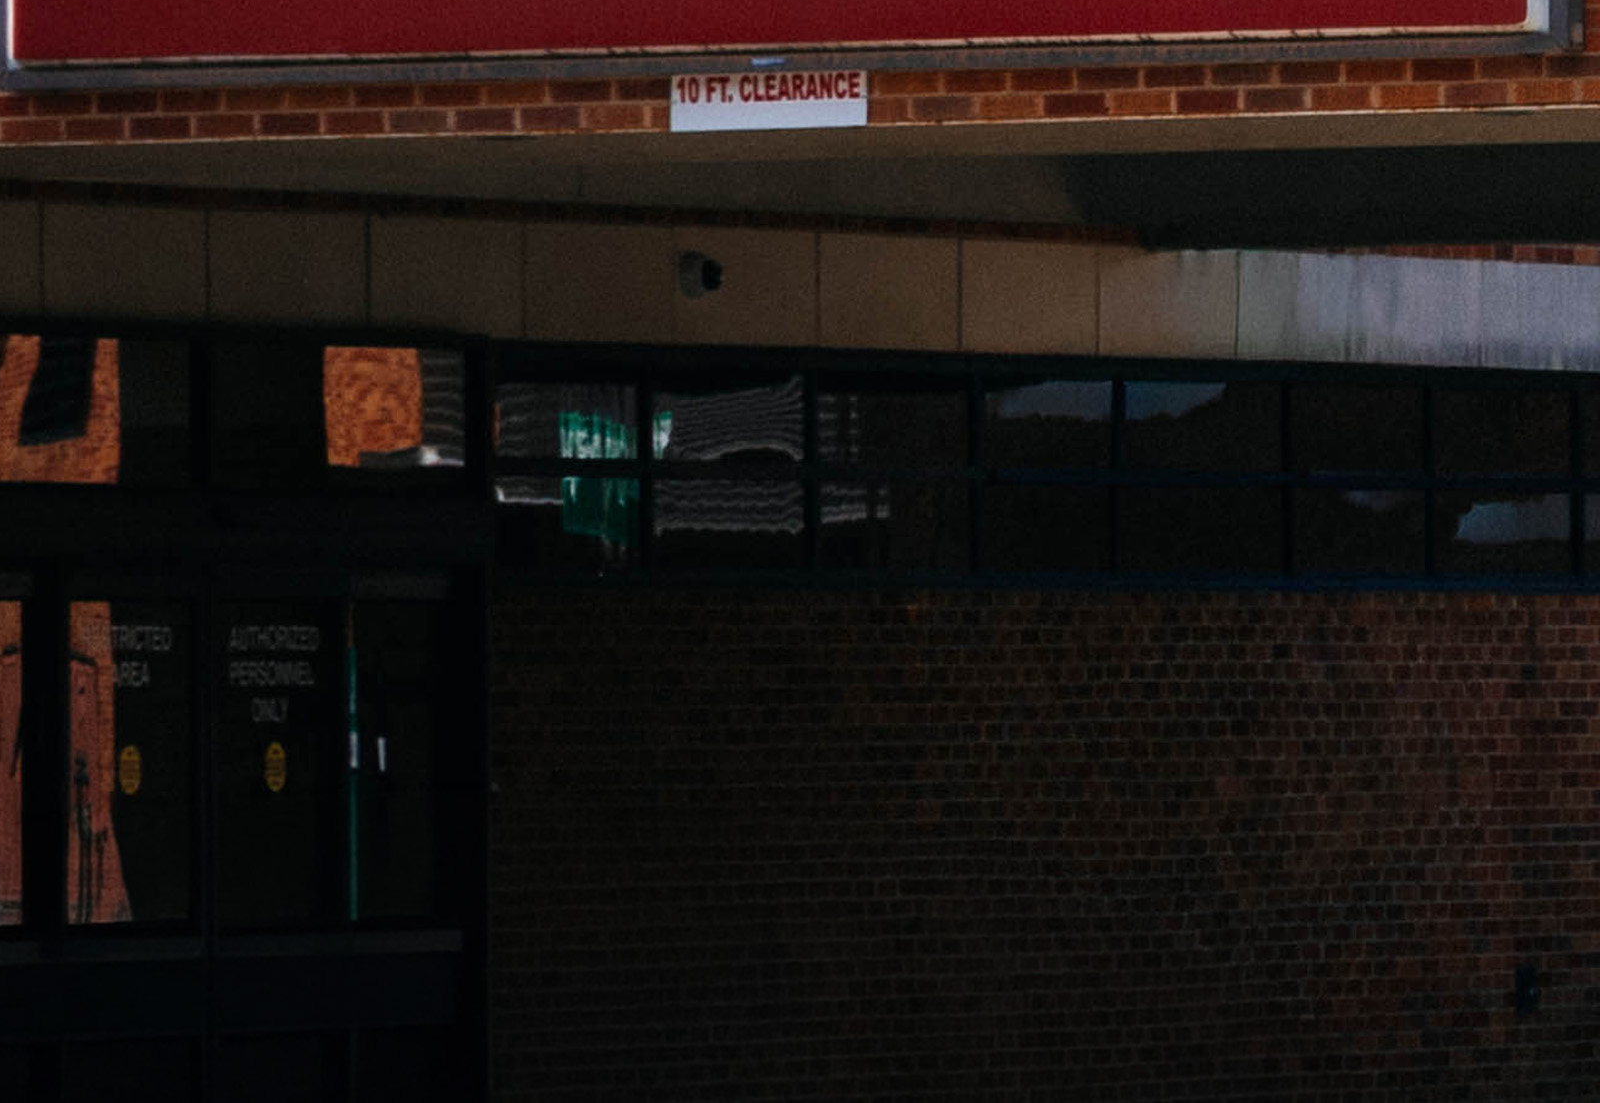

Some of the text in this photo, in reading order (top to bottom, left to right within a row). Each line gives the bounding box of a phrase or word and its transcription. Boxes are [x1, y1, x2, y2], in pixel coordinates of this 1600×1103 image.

[677, 72, 861, 104] 10 FT. CLEARANCE
[229, 625, 320, 652] AUTHORIZED
[229, 661, 316, 686] PERSONNEL
